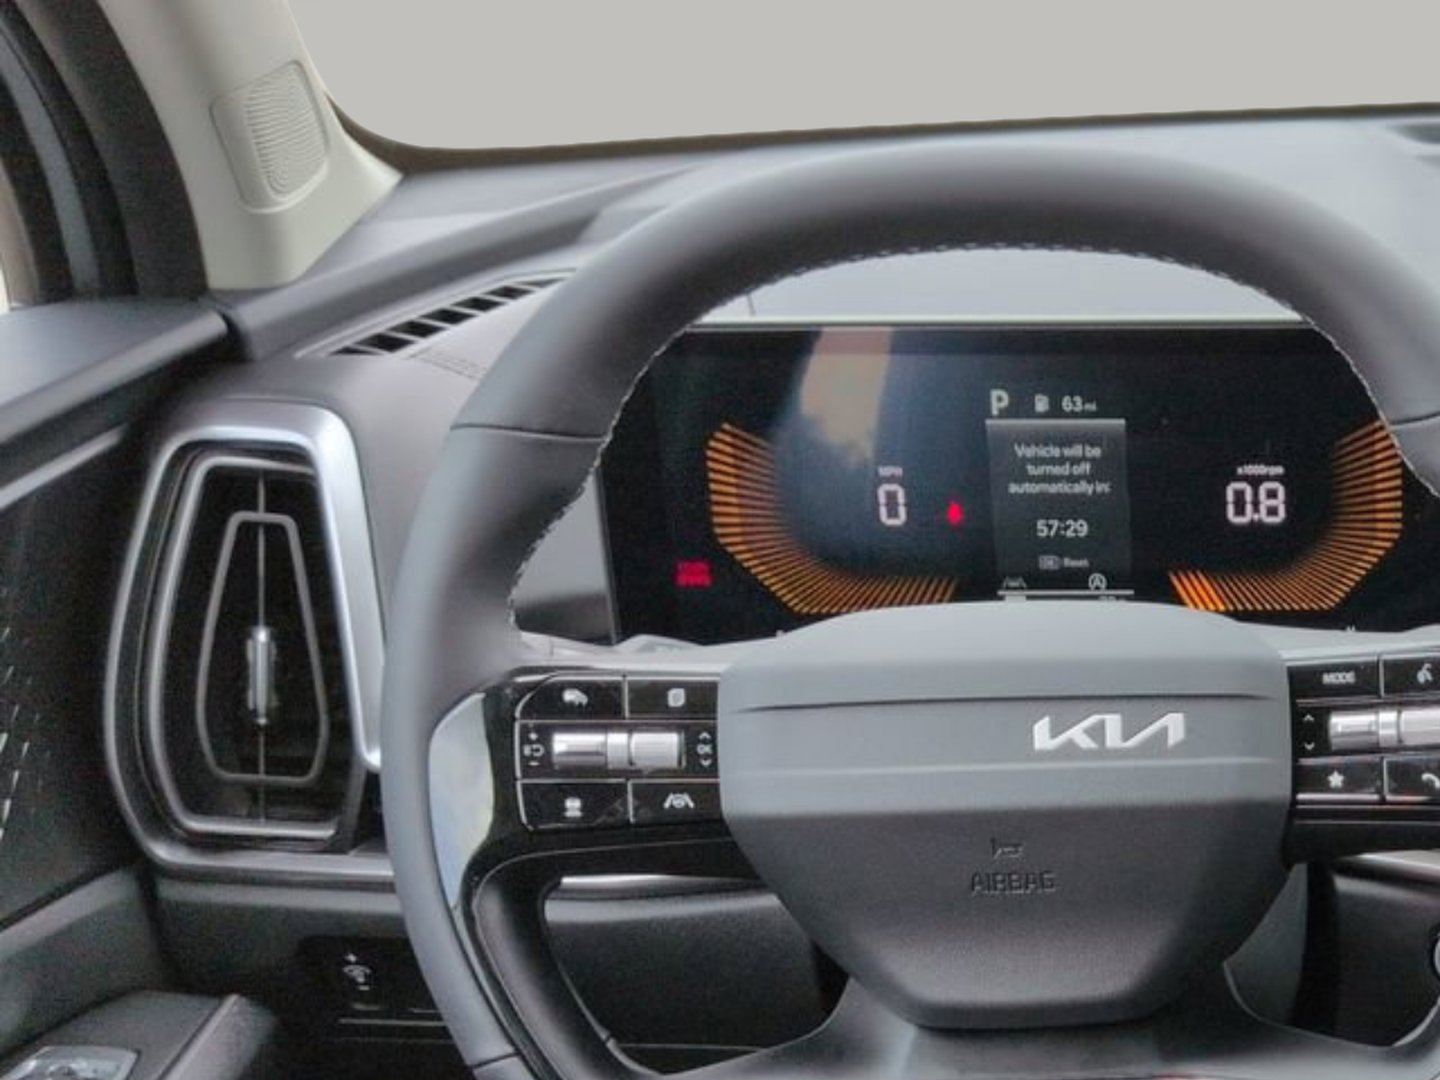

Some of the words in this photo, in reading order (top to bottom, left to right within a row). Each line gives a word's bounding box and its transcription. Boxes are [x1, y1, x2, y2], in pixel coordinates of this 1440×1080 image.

[990, 388, 1010, 416] P
[1014, 443, 1061, 458] Vehicle
[1063, 443, 1084, 458] will
[1084, 443, 1101, 458] be
[1026, 462, 1070, 476] turned
[1072, 462, 1092, 476] off
[1008, 480, 1095, 495] automatically
[877, 483, 907, 526] 0
[1226, 481, 1286, 525] 0.8
[1036, 519, 1089, 538] 57:29
[1322, 671, 1357, 685] MODE
[1032, 711, 1185, 752] KIA
[970, 870, 1057, 896] AIRBAG
